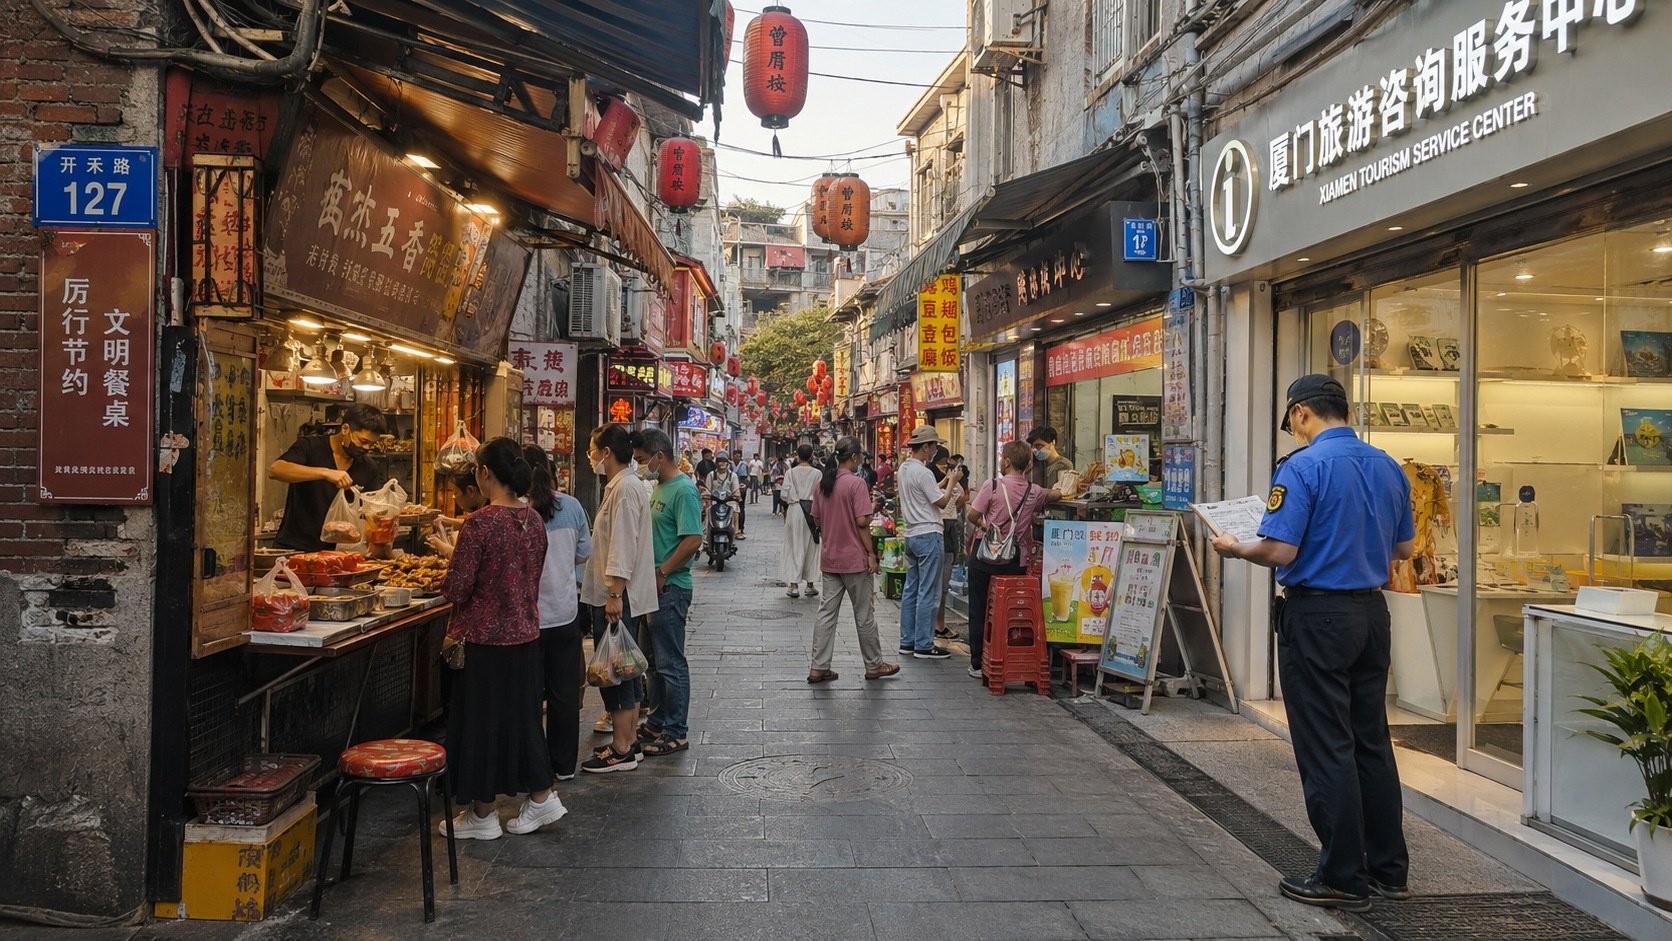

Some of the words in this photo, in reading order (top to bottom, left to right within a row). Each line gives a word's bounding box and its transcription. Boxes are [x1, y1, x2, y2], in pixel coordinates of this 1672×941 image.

[60, 156, 131, 175] 开禾路
[63, 181, 128, 216] 127
[1319, 172, 1358, 205] XIAMEN
[1359, 147, 1411, 187] TOURISM
[1412, 119, 1471, 165] SERVICE
[1472, 91, 1537, 140] CENTER
[61, 278, 90, 396] 厉行节约
[102, 308, 131, 427] 文明餐桌
